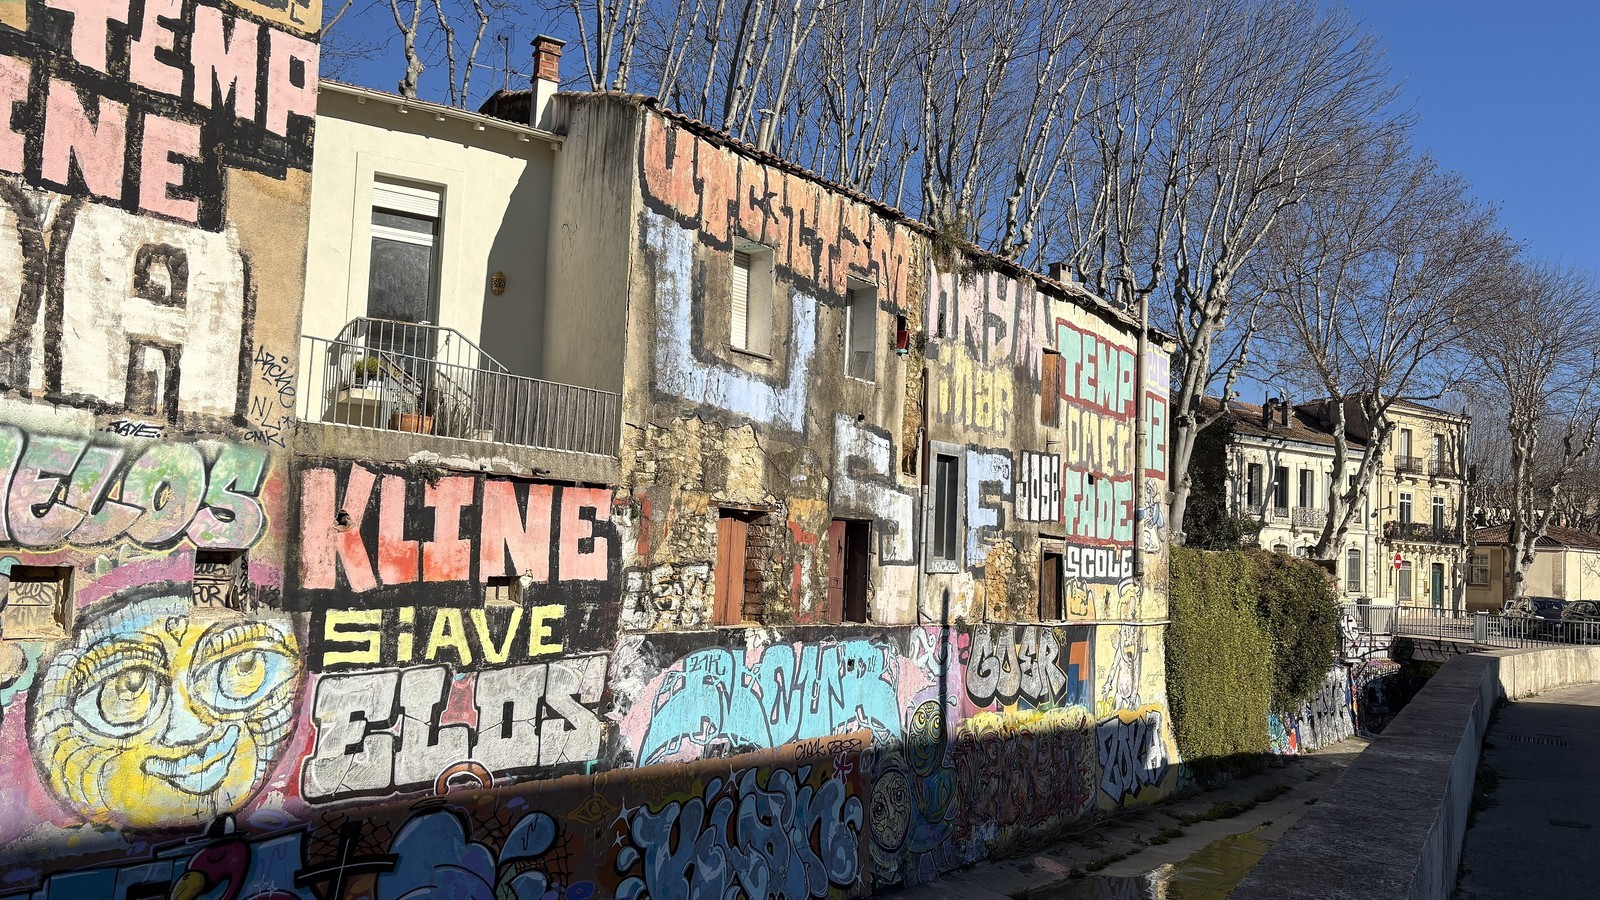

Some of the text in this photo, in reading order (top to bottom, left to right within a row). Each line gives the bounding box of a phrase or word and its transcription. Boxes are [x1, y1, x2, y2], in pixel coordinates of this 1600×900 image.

[45, 0, 320, 138] TEMP
[1057, 324, 1136, 414] TEMP
[301, 463, 612, 592] KLINE
[1064, 468, 1134, 542] FADE
[303, 655, 610, 801] ELOS
